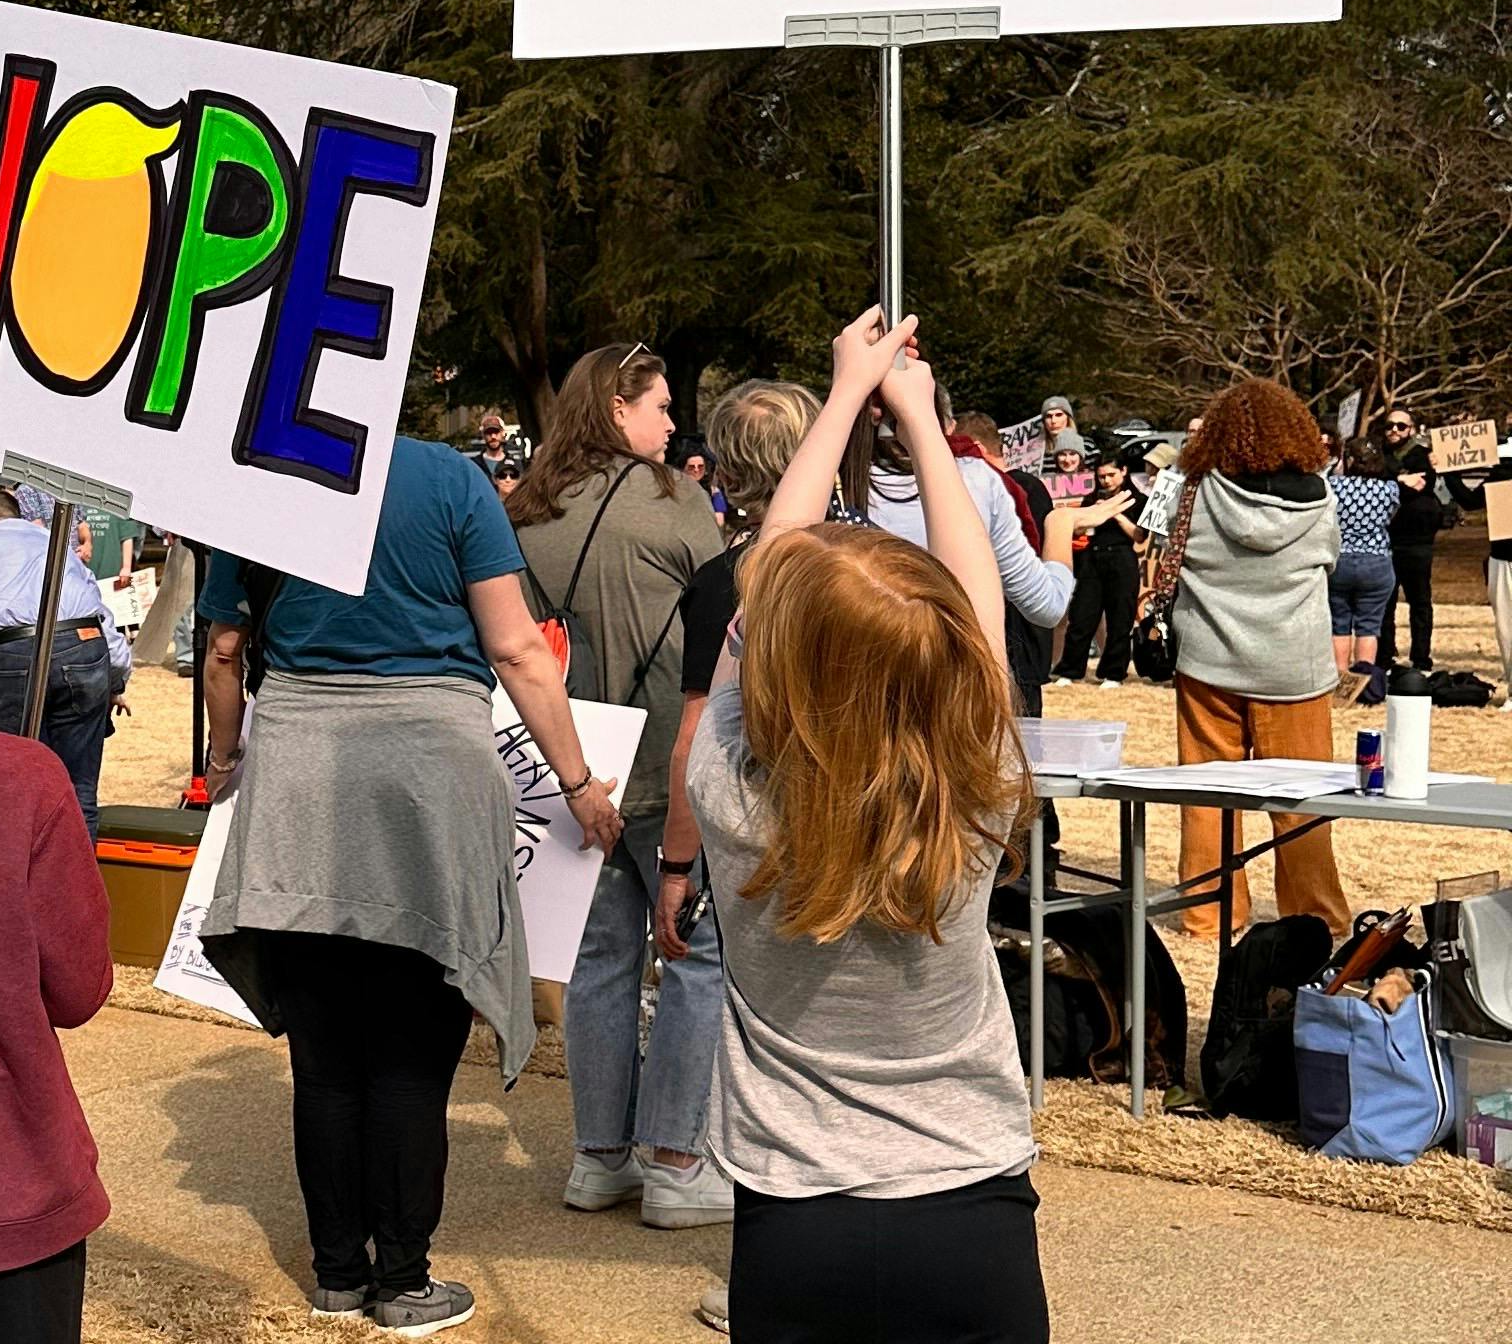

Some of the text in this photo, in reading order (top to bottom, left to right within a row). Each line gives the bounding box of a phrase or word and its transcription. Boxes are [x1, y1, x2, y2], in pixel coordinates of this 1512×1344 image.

[1000, 419, 1042, 448] RANS
[1439, 424, 1487, 442] PUNCH
[1460, 440, 1470, 450] A
[1446, 449, 1486, 467] NAZI
[494, 722, 563, 882] AGAINS
[170, 944, 185, 964] BY
